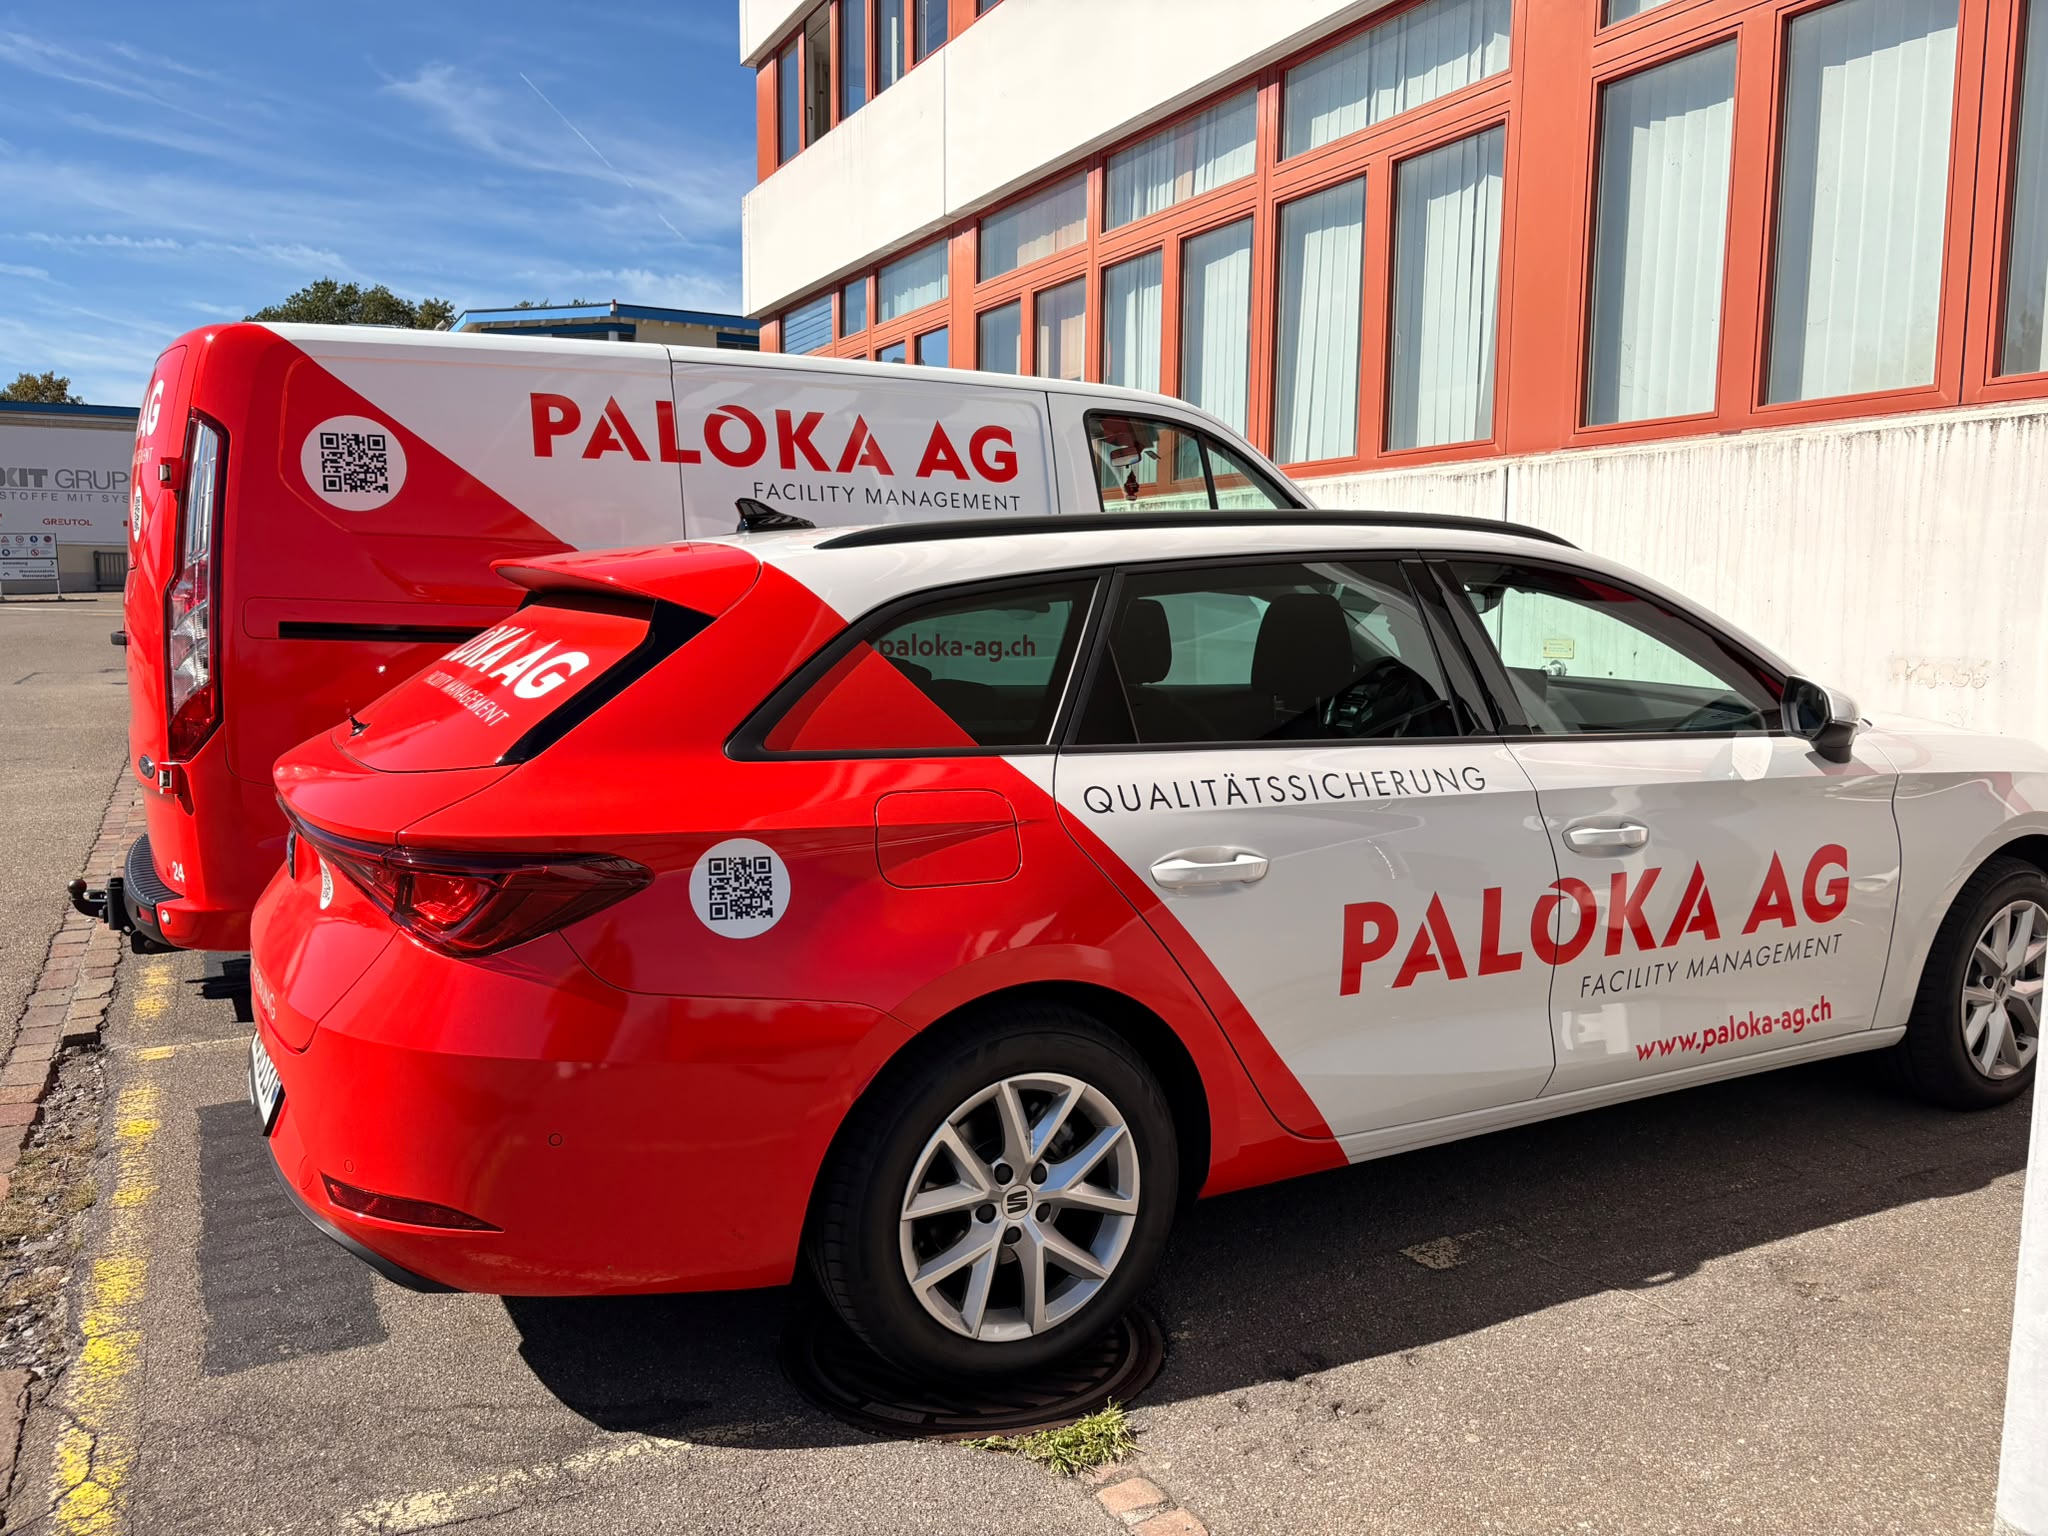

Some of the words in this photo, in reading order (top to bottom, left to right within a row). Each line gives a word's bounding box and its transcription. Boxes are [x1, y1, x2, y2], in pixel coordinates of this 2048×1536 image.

[530, 392, 894, 476] PALOKA
[915, 420, 1018, 484] AG
[55, 469, 131, 490] GRUP
[67, 493, 93, 503] MIT
[754, 482, 855, 504] FACILITY
[865, 488, 1021, 512] MANAGEMENT
[42, 518, 93, 527] GREUTOL
[487, 639, 590, 699] AG
[878, 633, 1036, 663] paloka-ag.ch
[440, 680, 511, 727] MANAGEMENT
[1083, 765, 1486, 814] QUALITÄTSSICHERUNG
[172, 860, 186, 883] 24
[1339, 859, 1721, 997] PALOKA
[1742, 844, 1849, 935] AG
[1580, 960, 1679, 998] FACILITY
[1687, 933, 1843, 981] MANAGEMENT
[1636, 996, 1832, 1060] www.paloka-ag.ch
